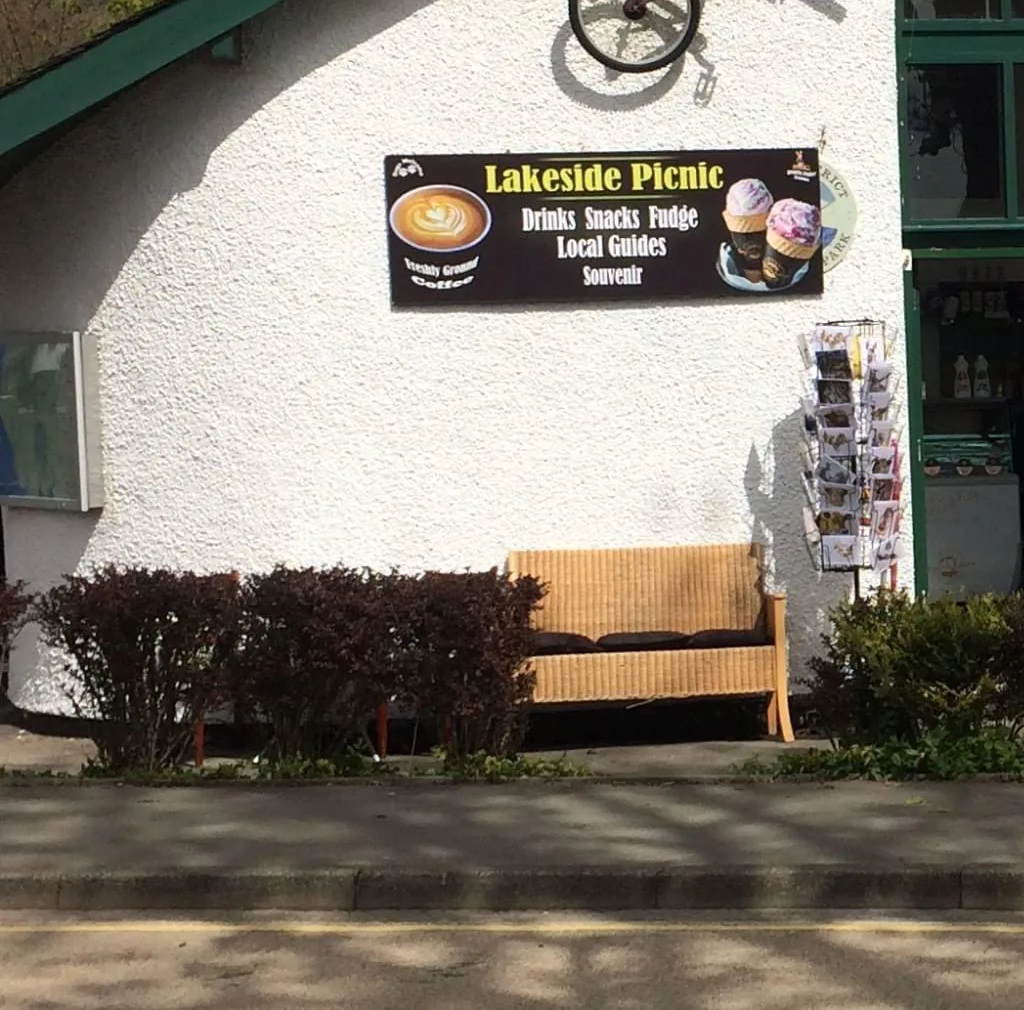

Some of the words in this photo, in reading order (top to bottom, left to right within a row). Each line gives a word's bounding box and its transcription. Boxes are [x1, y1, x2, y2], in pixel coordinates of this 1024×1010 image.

[485, 163, 622, 193] Lakeside
[631, 161, 724, 190] Picnic
[820, 165, 849, 198] RICT
[522, 207, 576, 232] Drinks
[585, 206, 640, 230] Snacks
[649, 204, 699, 231] Fudge
[557, 234, 604, 259] Local
[608, 233, 667, 258] Guides
[411, 275, 475, 289] Coffee
[583, 264, 643, 286] Souvenir
